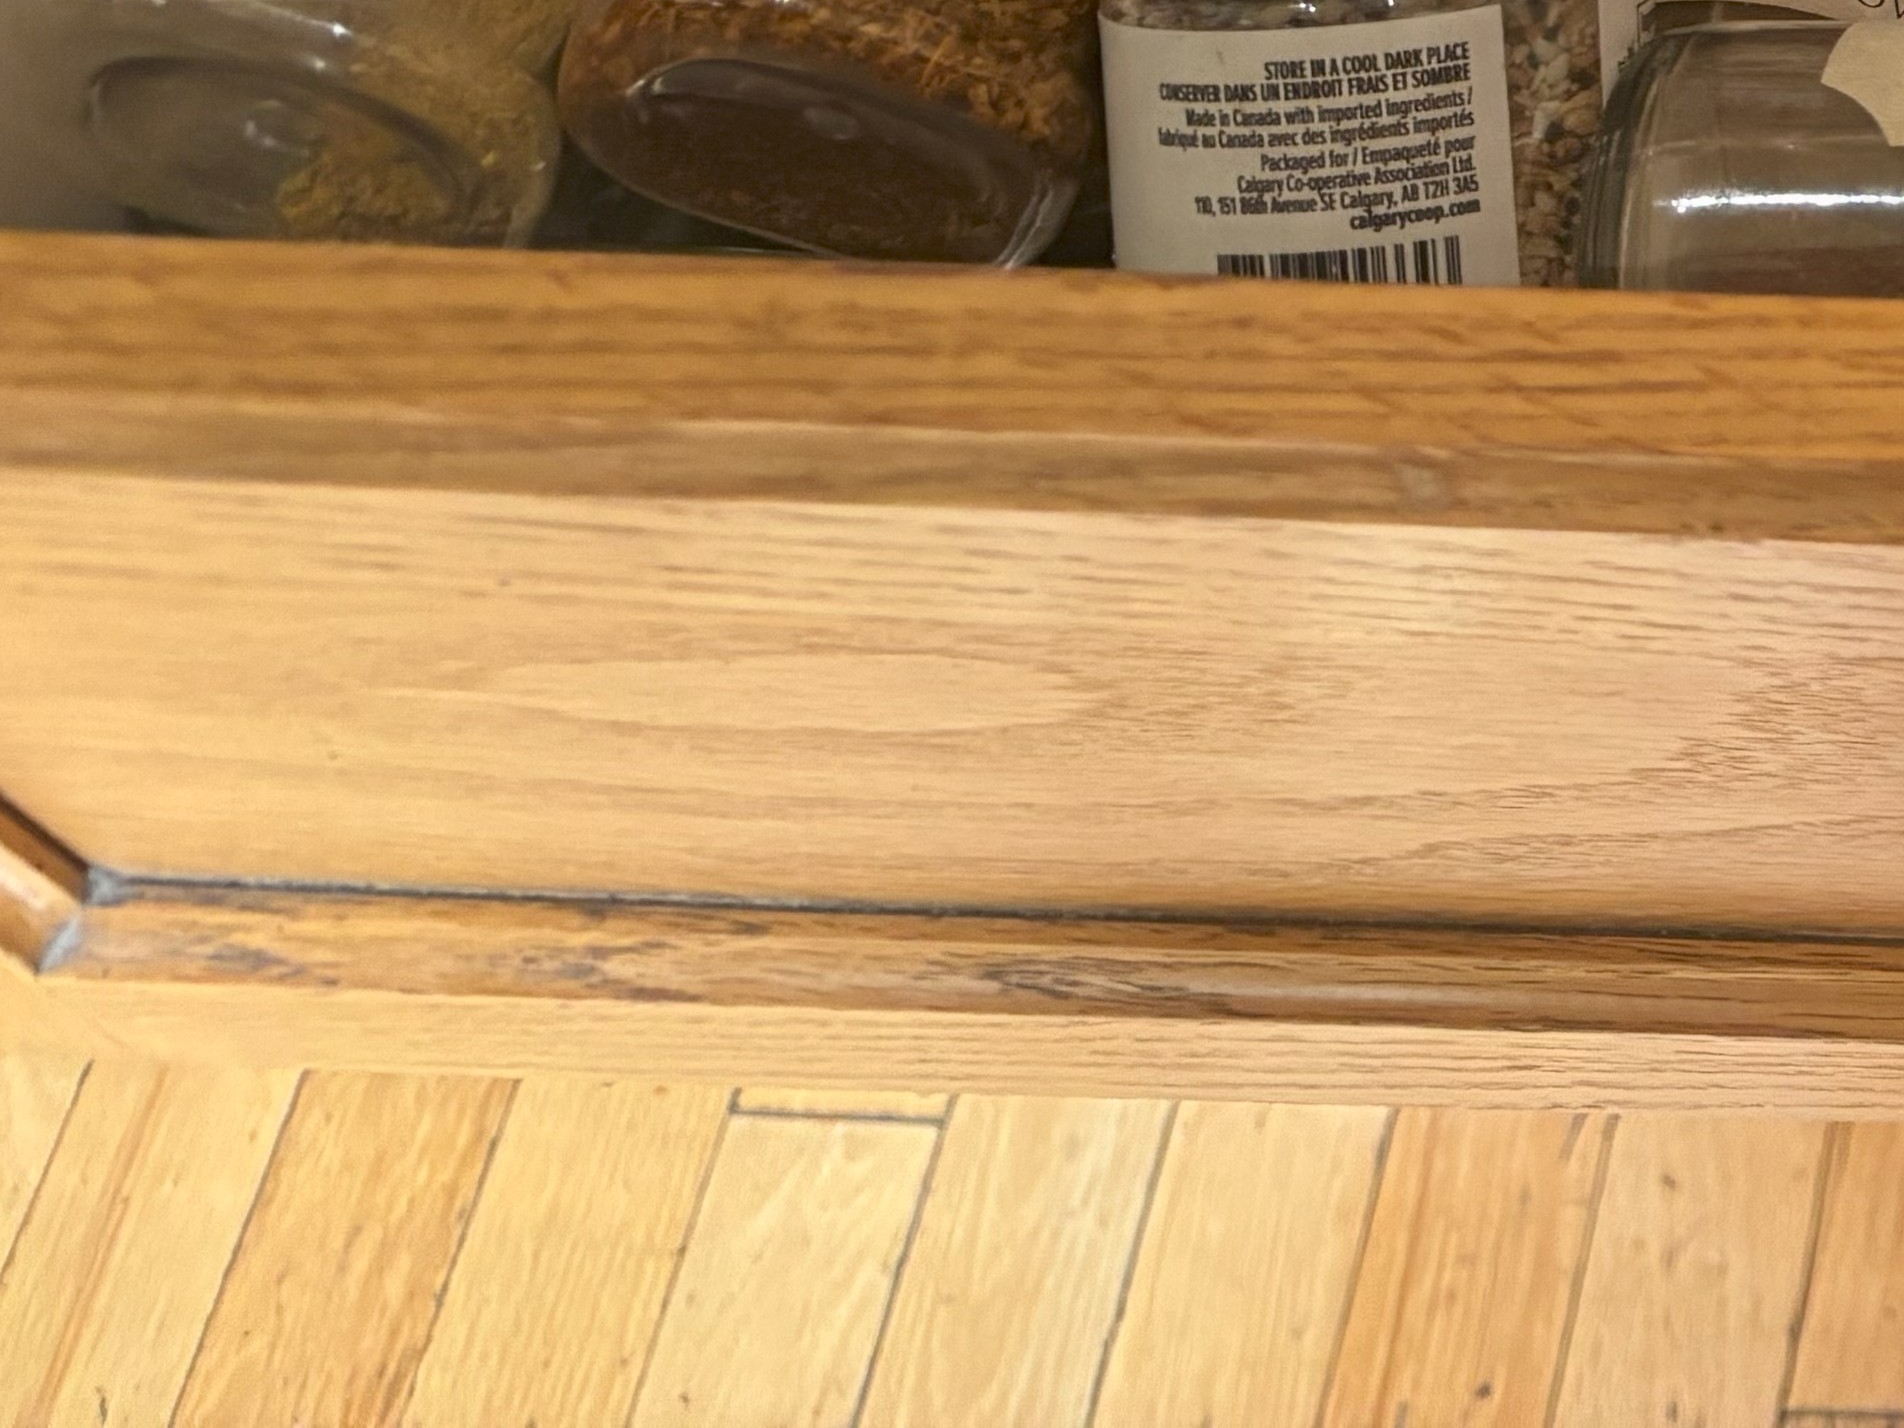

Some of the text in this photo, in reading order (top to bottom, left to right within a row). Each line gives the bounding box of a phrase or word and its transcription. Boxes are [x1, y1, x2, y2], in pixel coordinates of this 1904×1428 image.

[1264, 41, 1470, 81] STORE COOL DARK PLACE
[1348, 62, 1471, 95] FRAIS SOMBRE
[1260, 151, 1326, 174] Packaged
[1286, 160, 1450, 194] Co-operative Association
[1350, 198, 1481, 233] calgarycoop.com
